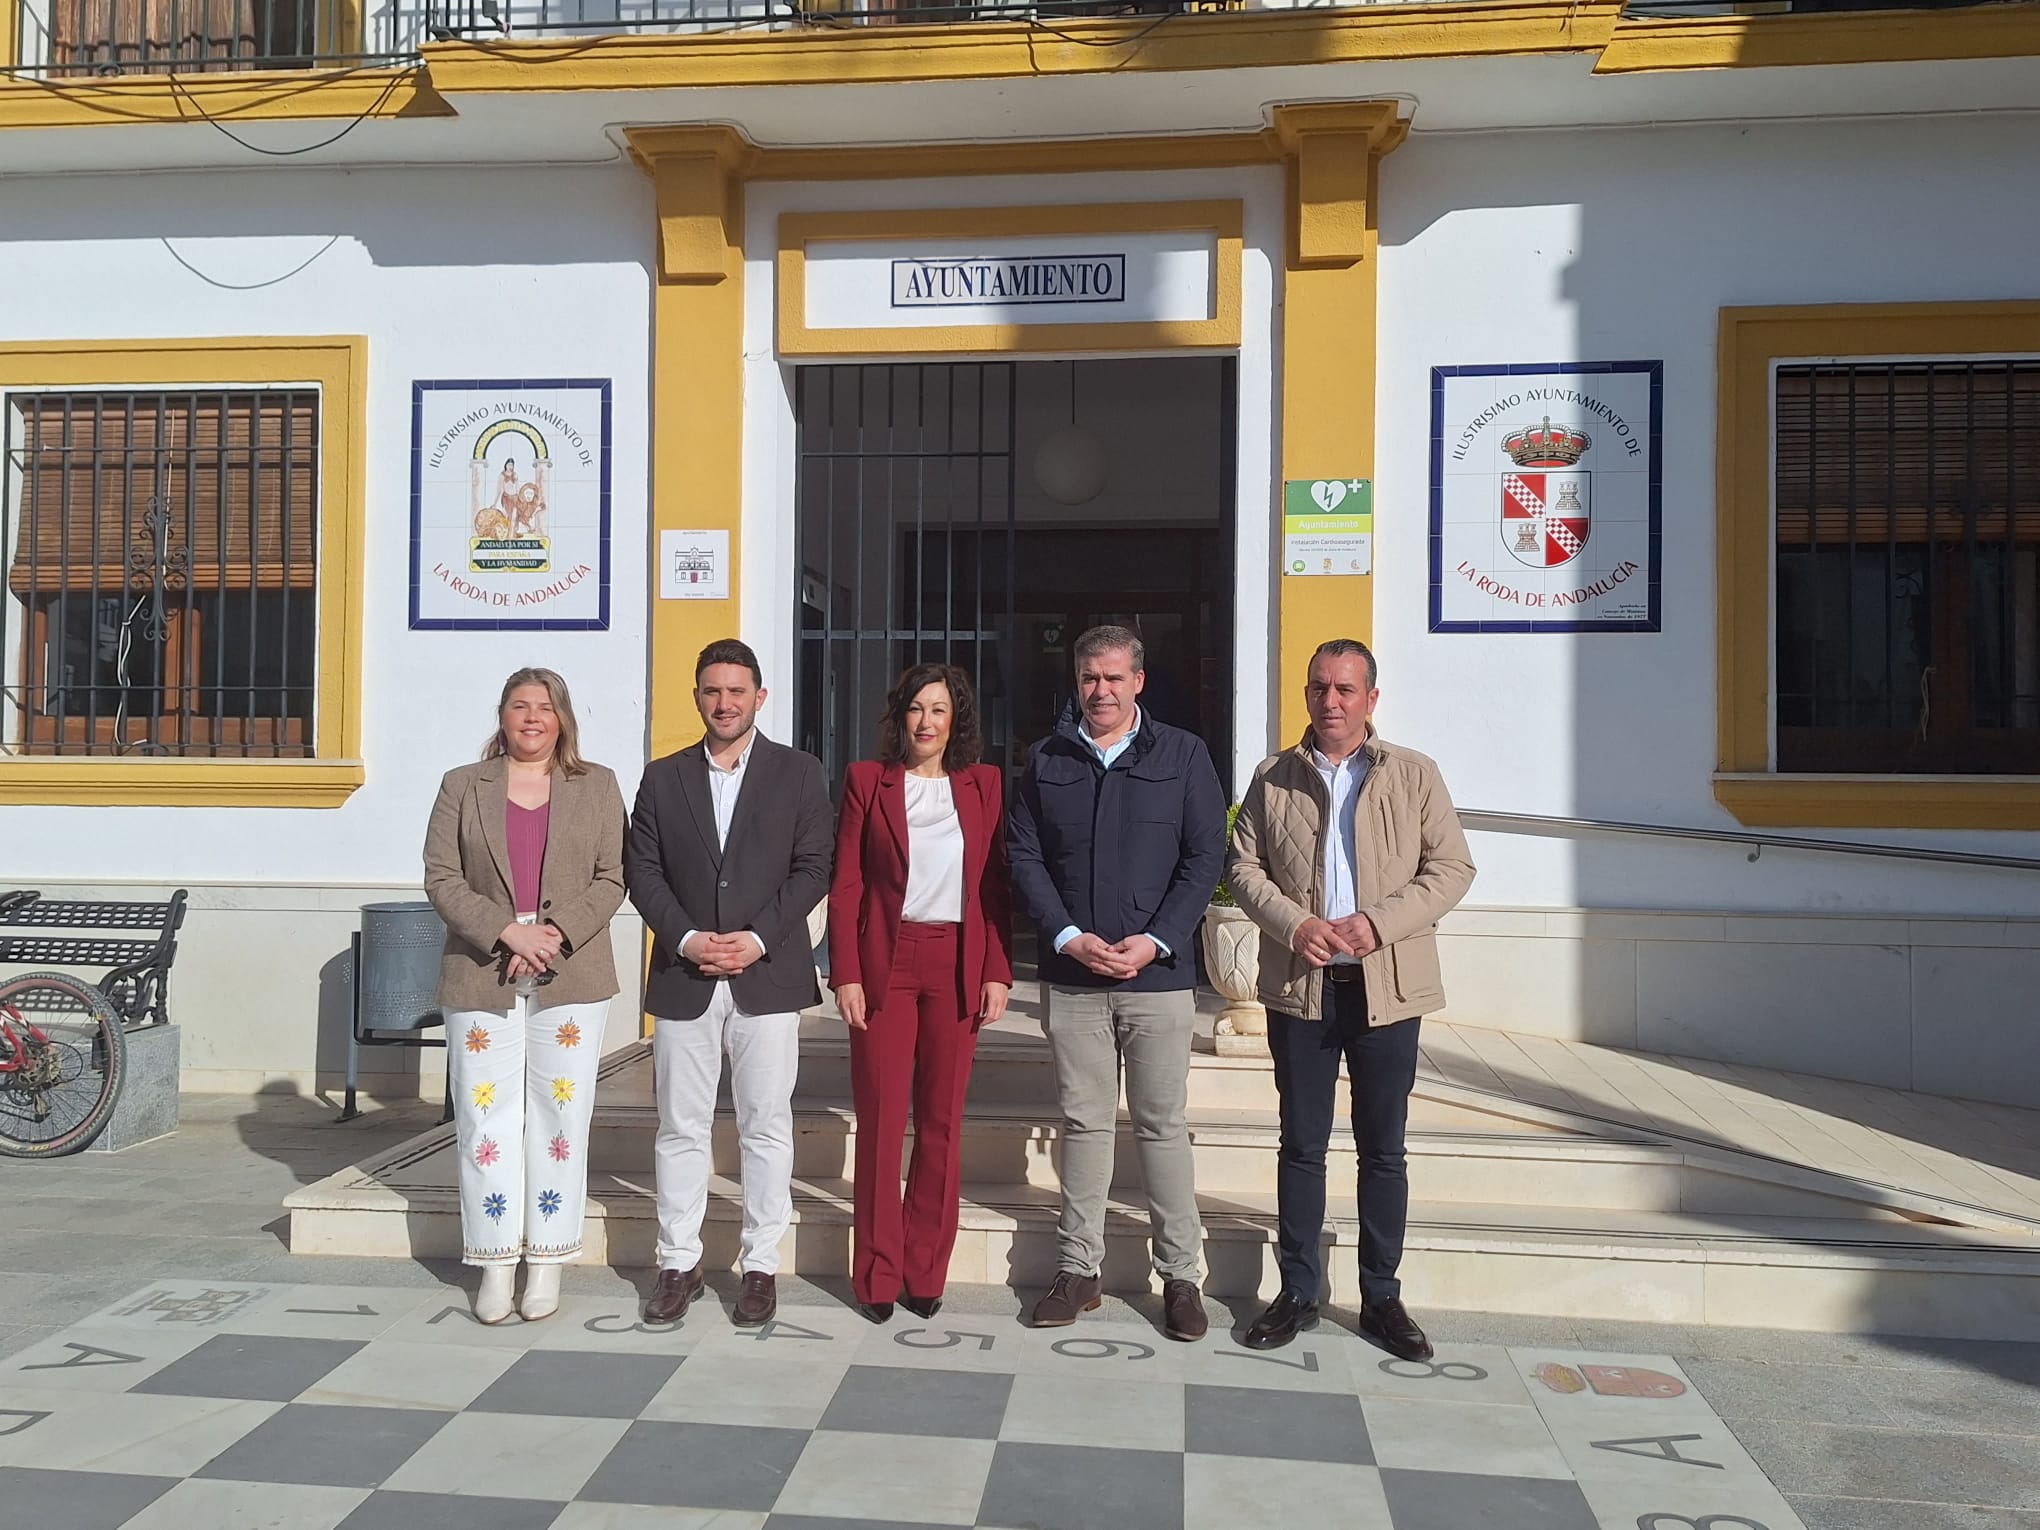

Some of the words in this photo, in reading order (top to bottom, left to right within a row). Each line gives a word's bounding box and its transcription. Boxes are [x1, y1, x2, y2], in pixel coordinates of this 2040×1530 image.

[905, 262, 1113, 299] AYUNTAMIENTO
[429, 407, 489, 469] ILUSTRISIMO
[493, 402, 583, 449] AYUNTAMIENTO
[578, 449, 594, 468] DE
[1452, 394, 1521, 460] ILUSTRISIMO
[1526, 388, 1629, 437] AYUNTAMIENTO
[1624, 437, 1642, 458] DE
[1298, 520, 1359, 530] Ayuntamiento
[433, 562, 449, 582] LA
[450, 576, 488, 604] RODA
[492, 592, 510, 607] DE
[515, 563, 592, 606] ANDALUCÍA
[1456, 560, 1476, 582] LA
[1476, 575, 1520, 604] RODA
[1525, 592, 1546, 607] DE
[1551, 561, 1640, 607] ANDALUCÍA
[284, 1304, 380, 1316] 1
[583, 1314, 685, 1334] 3
[734, 1320, 834, 1342] 4
[893, 1327, 996, 1352] 5
[1051, 1337, 1156, 1361] 6
[19, 1341, 147, 1370] A
[1213, 1349, 1320, 1373] 7
[1378, 1358, 1489, 1381] 8
[1589, 1433, 1725, 1470] A
